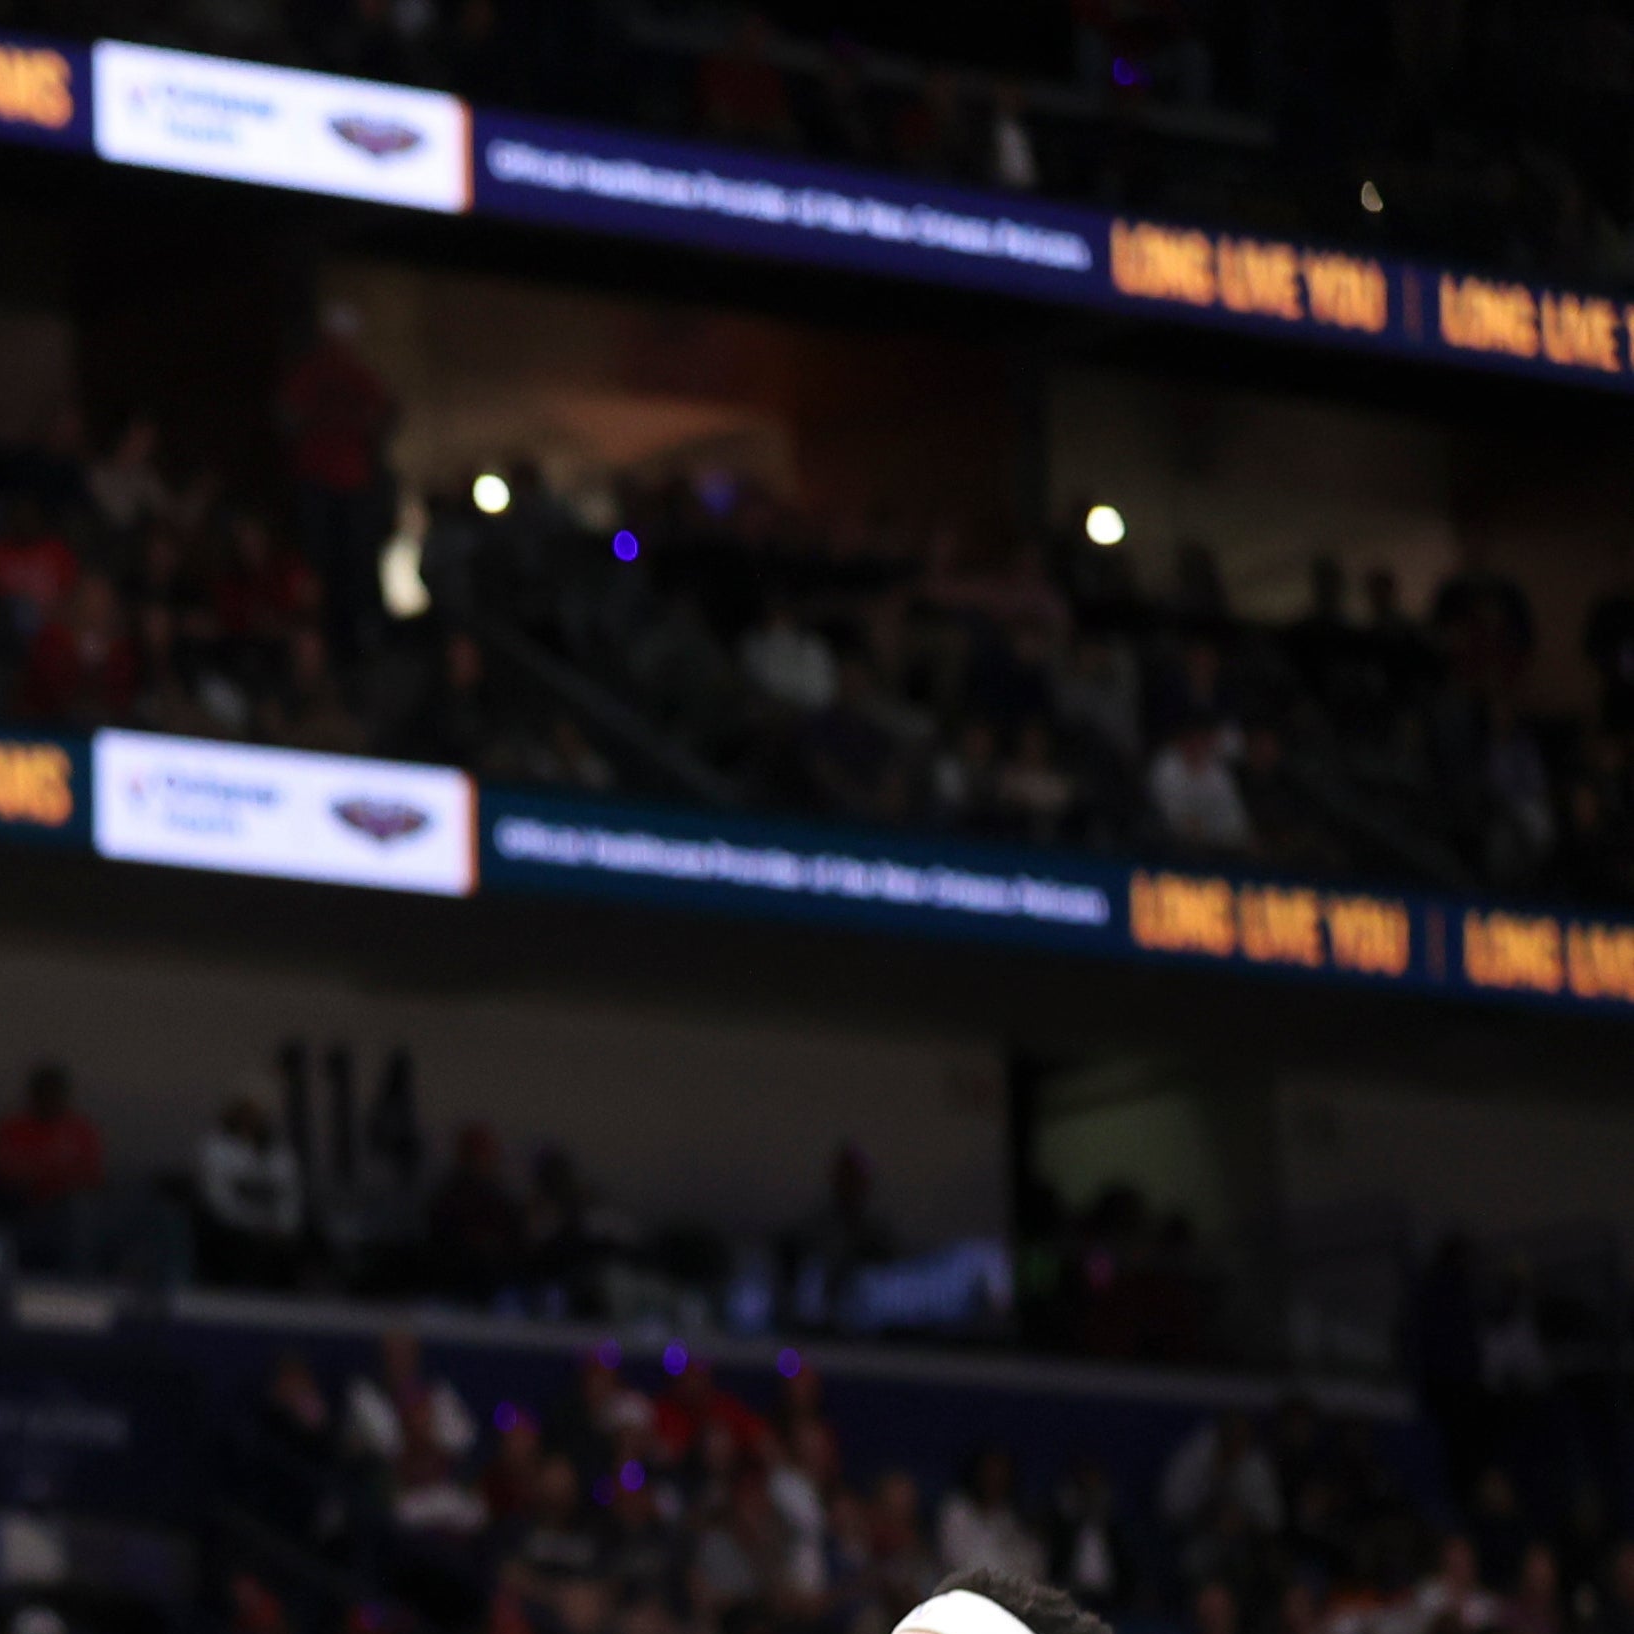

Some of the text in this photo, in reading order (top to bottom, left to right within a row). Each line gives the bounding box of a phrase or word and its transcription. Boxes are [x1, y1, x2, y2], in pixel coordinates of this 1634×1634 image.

[1110, 217, 1388, 334] LONG LIVE YOU
[1438, 272, 1539, 359] LONG
[1540, 288, 1622, 373] LIVE
[1129, 869, 1234, 957] LONG
[1325, 893, 1410, 979] YOU
[1462, 907, 1564, 994] LONG
